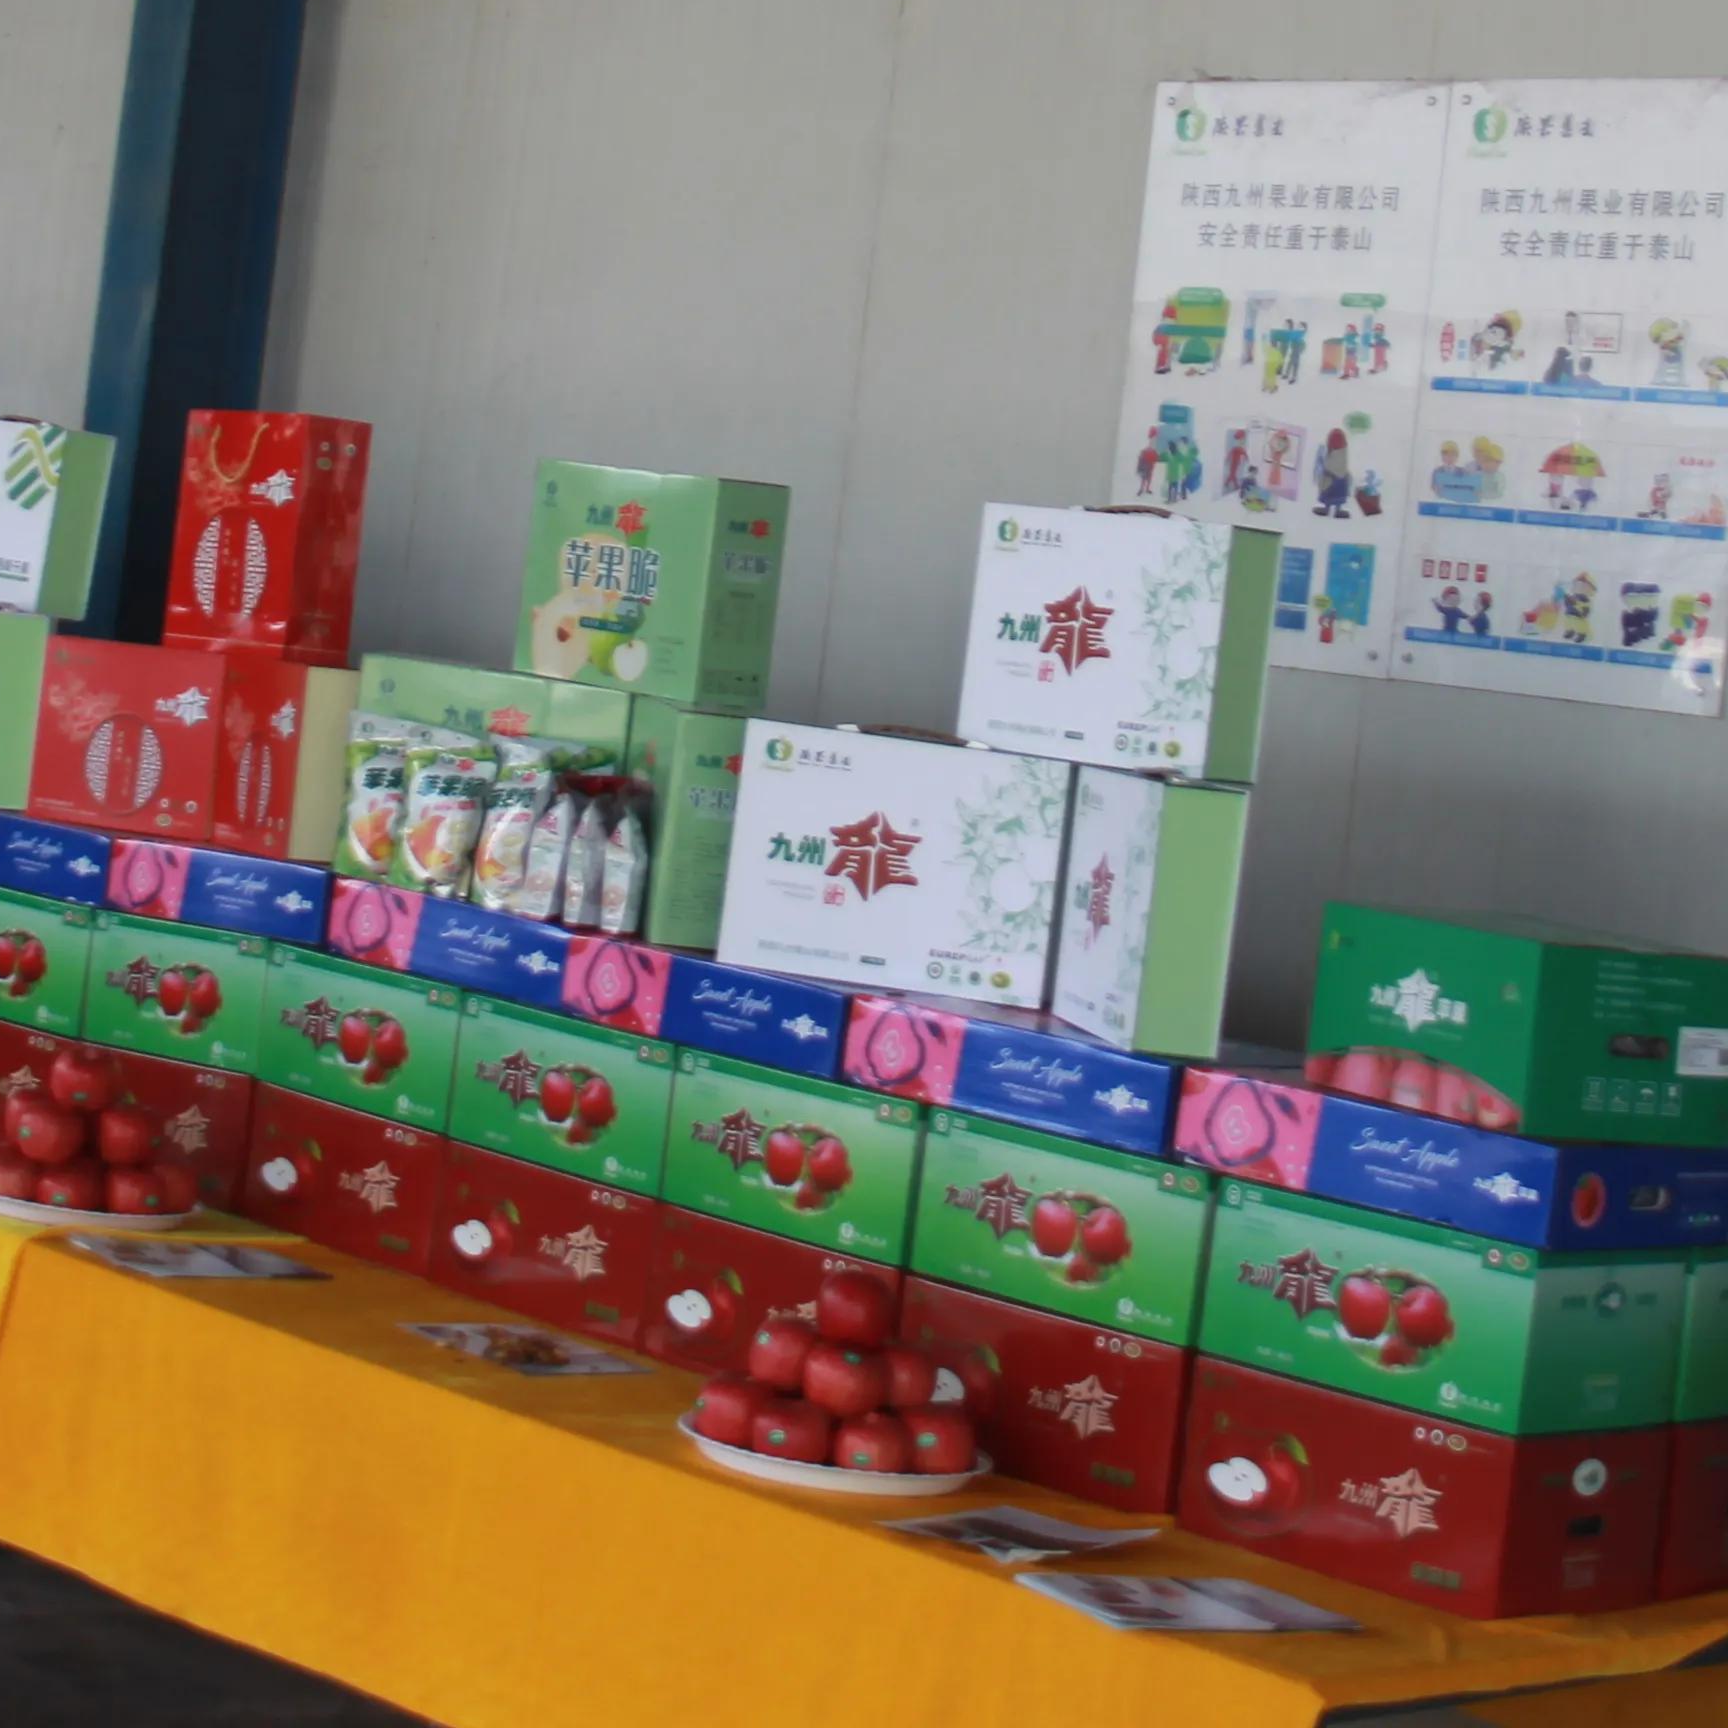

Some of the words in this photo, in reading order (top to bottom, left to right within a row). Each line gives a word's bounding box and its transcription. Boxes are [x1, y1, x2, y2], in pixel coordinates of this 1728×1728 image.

[1180, 182, 1401, 213] 陕西九州果业有限公司
[1479, 187, 1726, 219] 陕西九州果业有限公司
[1197, 223, 1372, 252] 安全责任重于泰山
[1500, 228, 1695, 261] 安全责任重于泰山
[563, 538, 660, 599] 苹果脆
